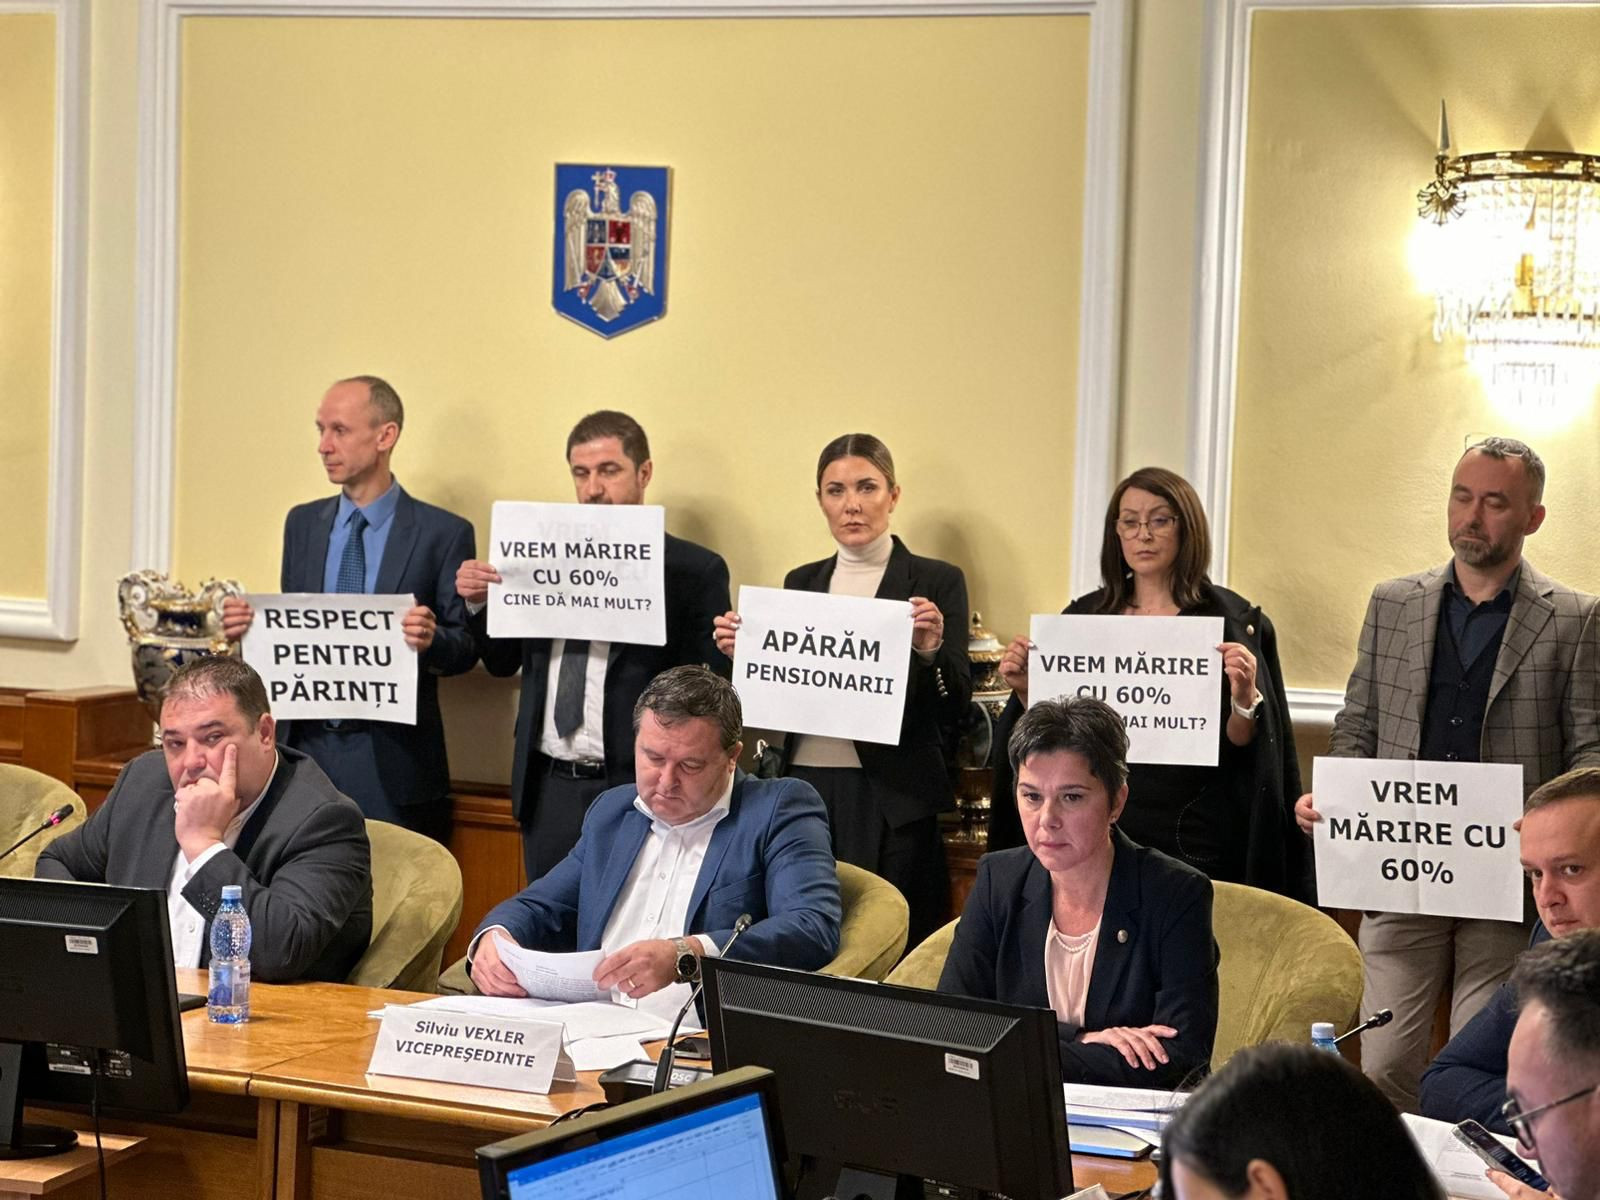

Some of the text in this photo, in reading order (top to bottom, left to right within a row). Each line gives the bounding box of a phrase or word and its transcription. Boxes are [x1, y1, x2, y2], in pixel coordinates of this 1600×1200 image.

[500, 537, 651, 560] VREM MĂRIRE
[532, 568, 561, 585] CU
[569, 569, 619, 587] 60%
[503, 591, 652, 611] CINE DĂ MAI MULT?
[264, 607, 395, 631] RESPECT
[273, 644, 392, 667] PENTRU
[761, 626, 881, 663] APĂRĂM
[1040, 651, 1209, 676] VREM MĂRIRE
[270, 674, 399, 708] PĂRINȚI
[746, 662, 894, 695] PENSIONARII
[1116, 686, 1171, 705] 60%
[1154, 716, 1207, 730] MULT?
[1371, 780, 1458, 806] VREM
[1329, 812, 1506, 848] MĂRIRE CU
[1381, 858, 1454, 884] 60%
[414, 1020, 525, 1046] Silviu VEXLER
